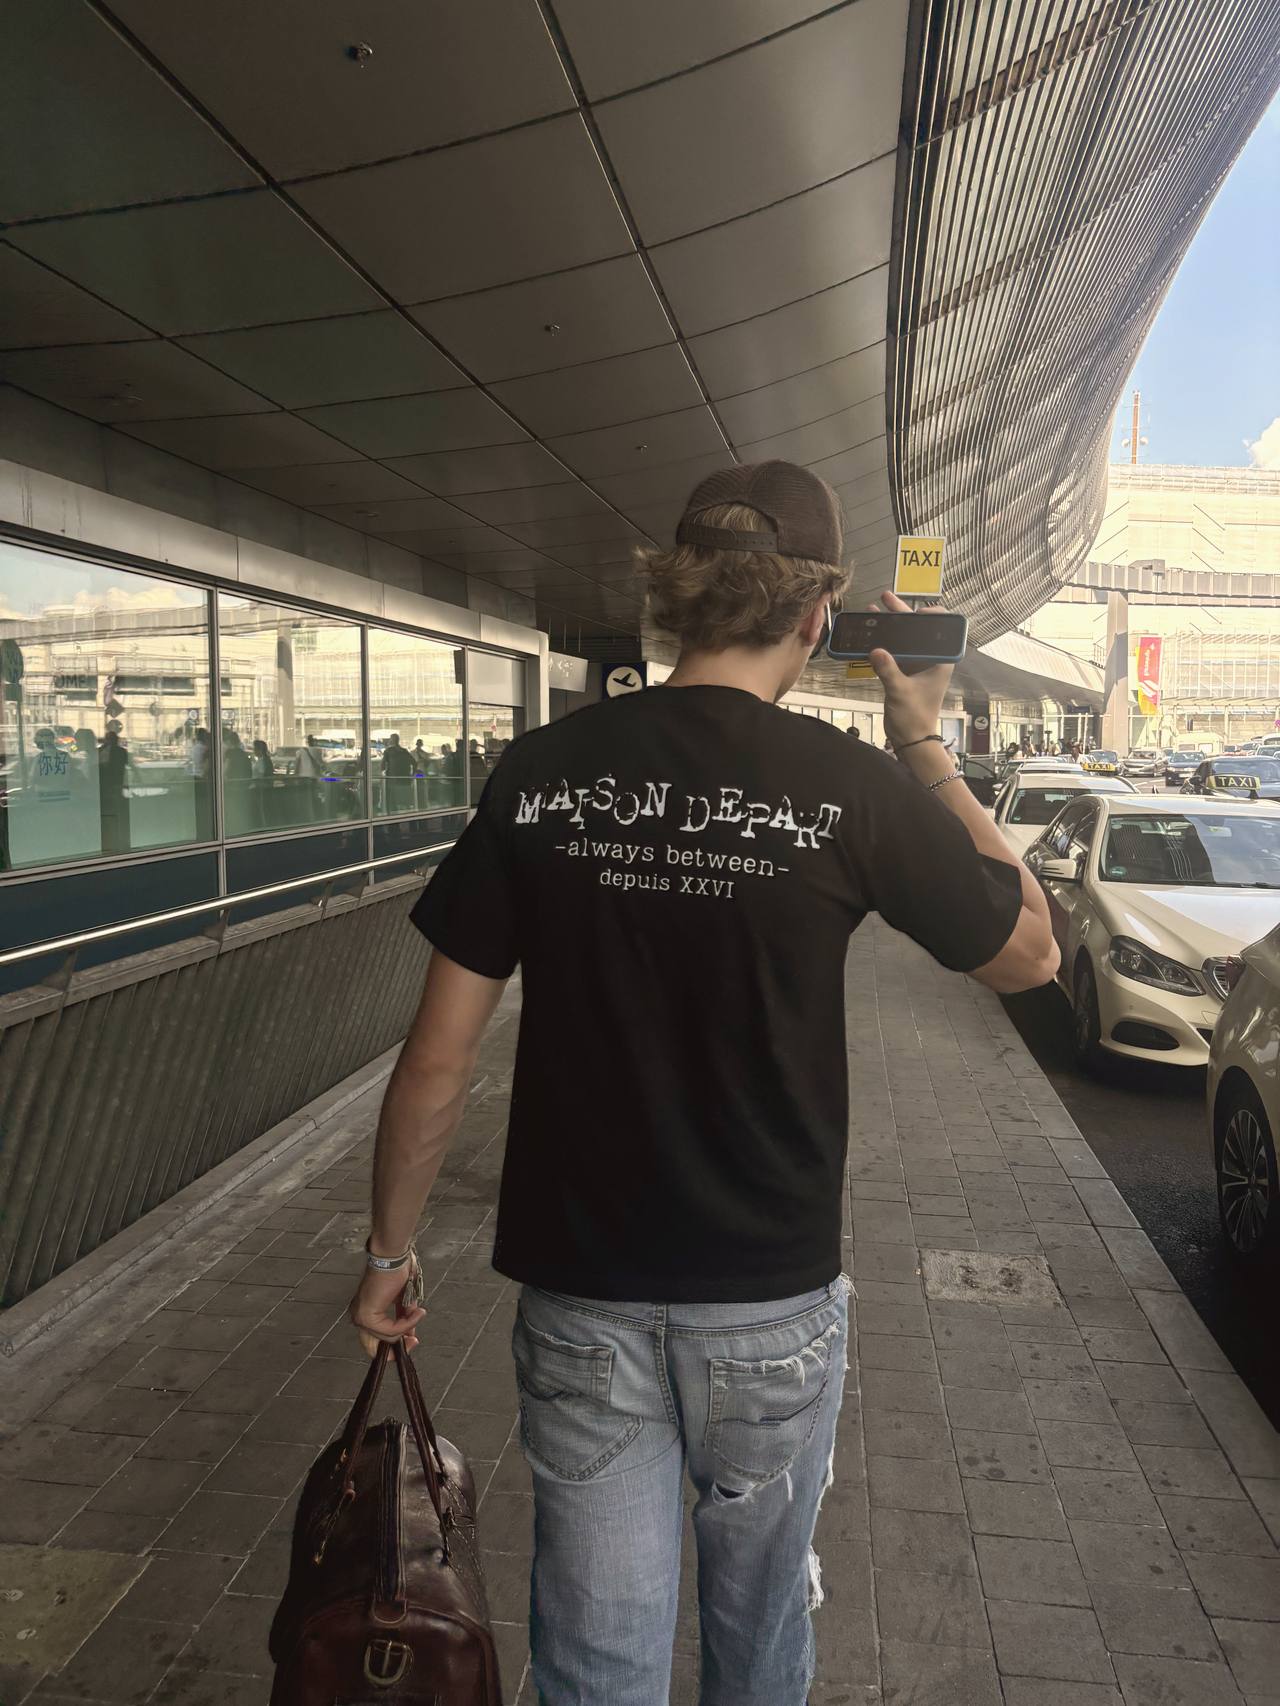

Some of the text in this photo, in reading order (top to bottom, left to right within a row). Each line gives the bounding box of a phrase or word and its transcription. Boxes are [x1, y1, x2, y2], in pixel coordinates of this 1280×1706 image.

[901, 550, 940, 567] TAXI
[1088, 762, 1111, 770] TAXI
[1218, 776, 1253, 787] TAXI
[599, 869, 735, 898] depuis XXVI
